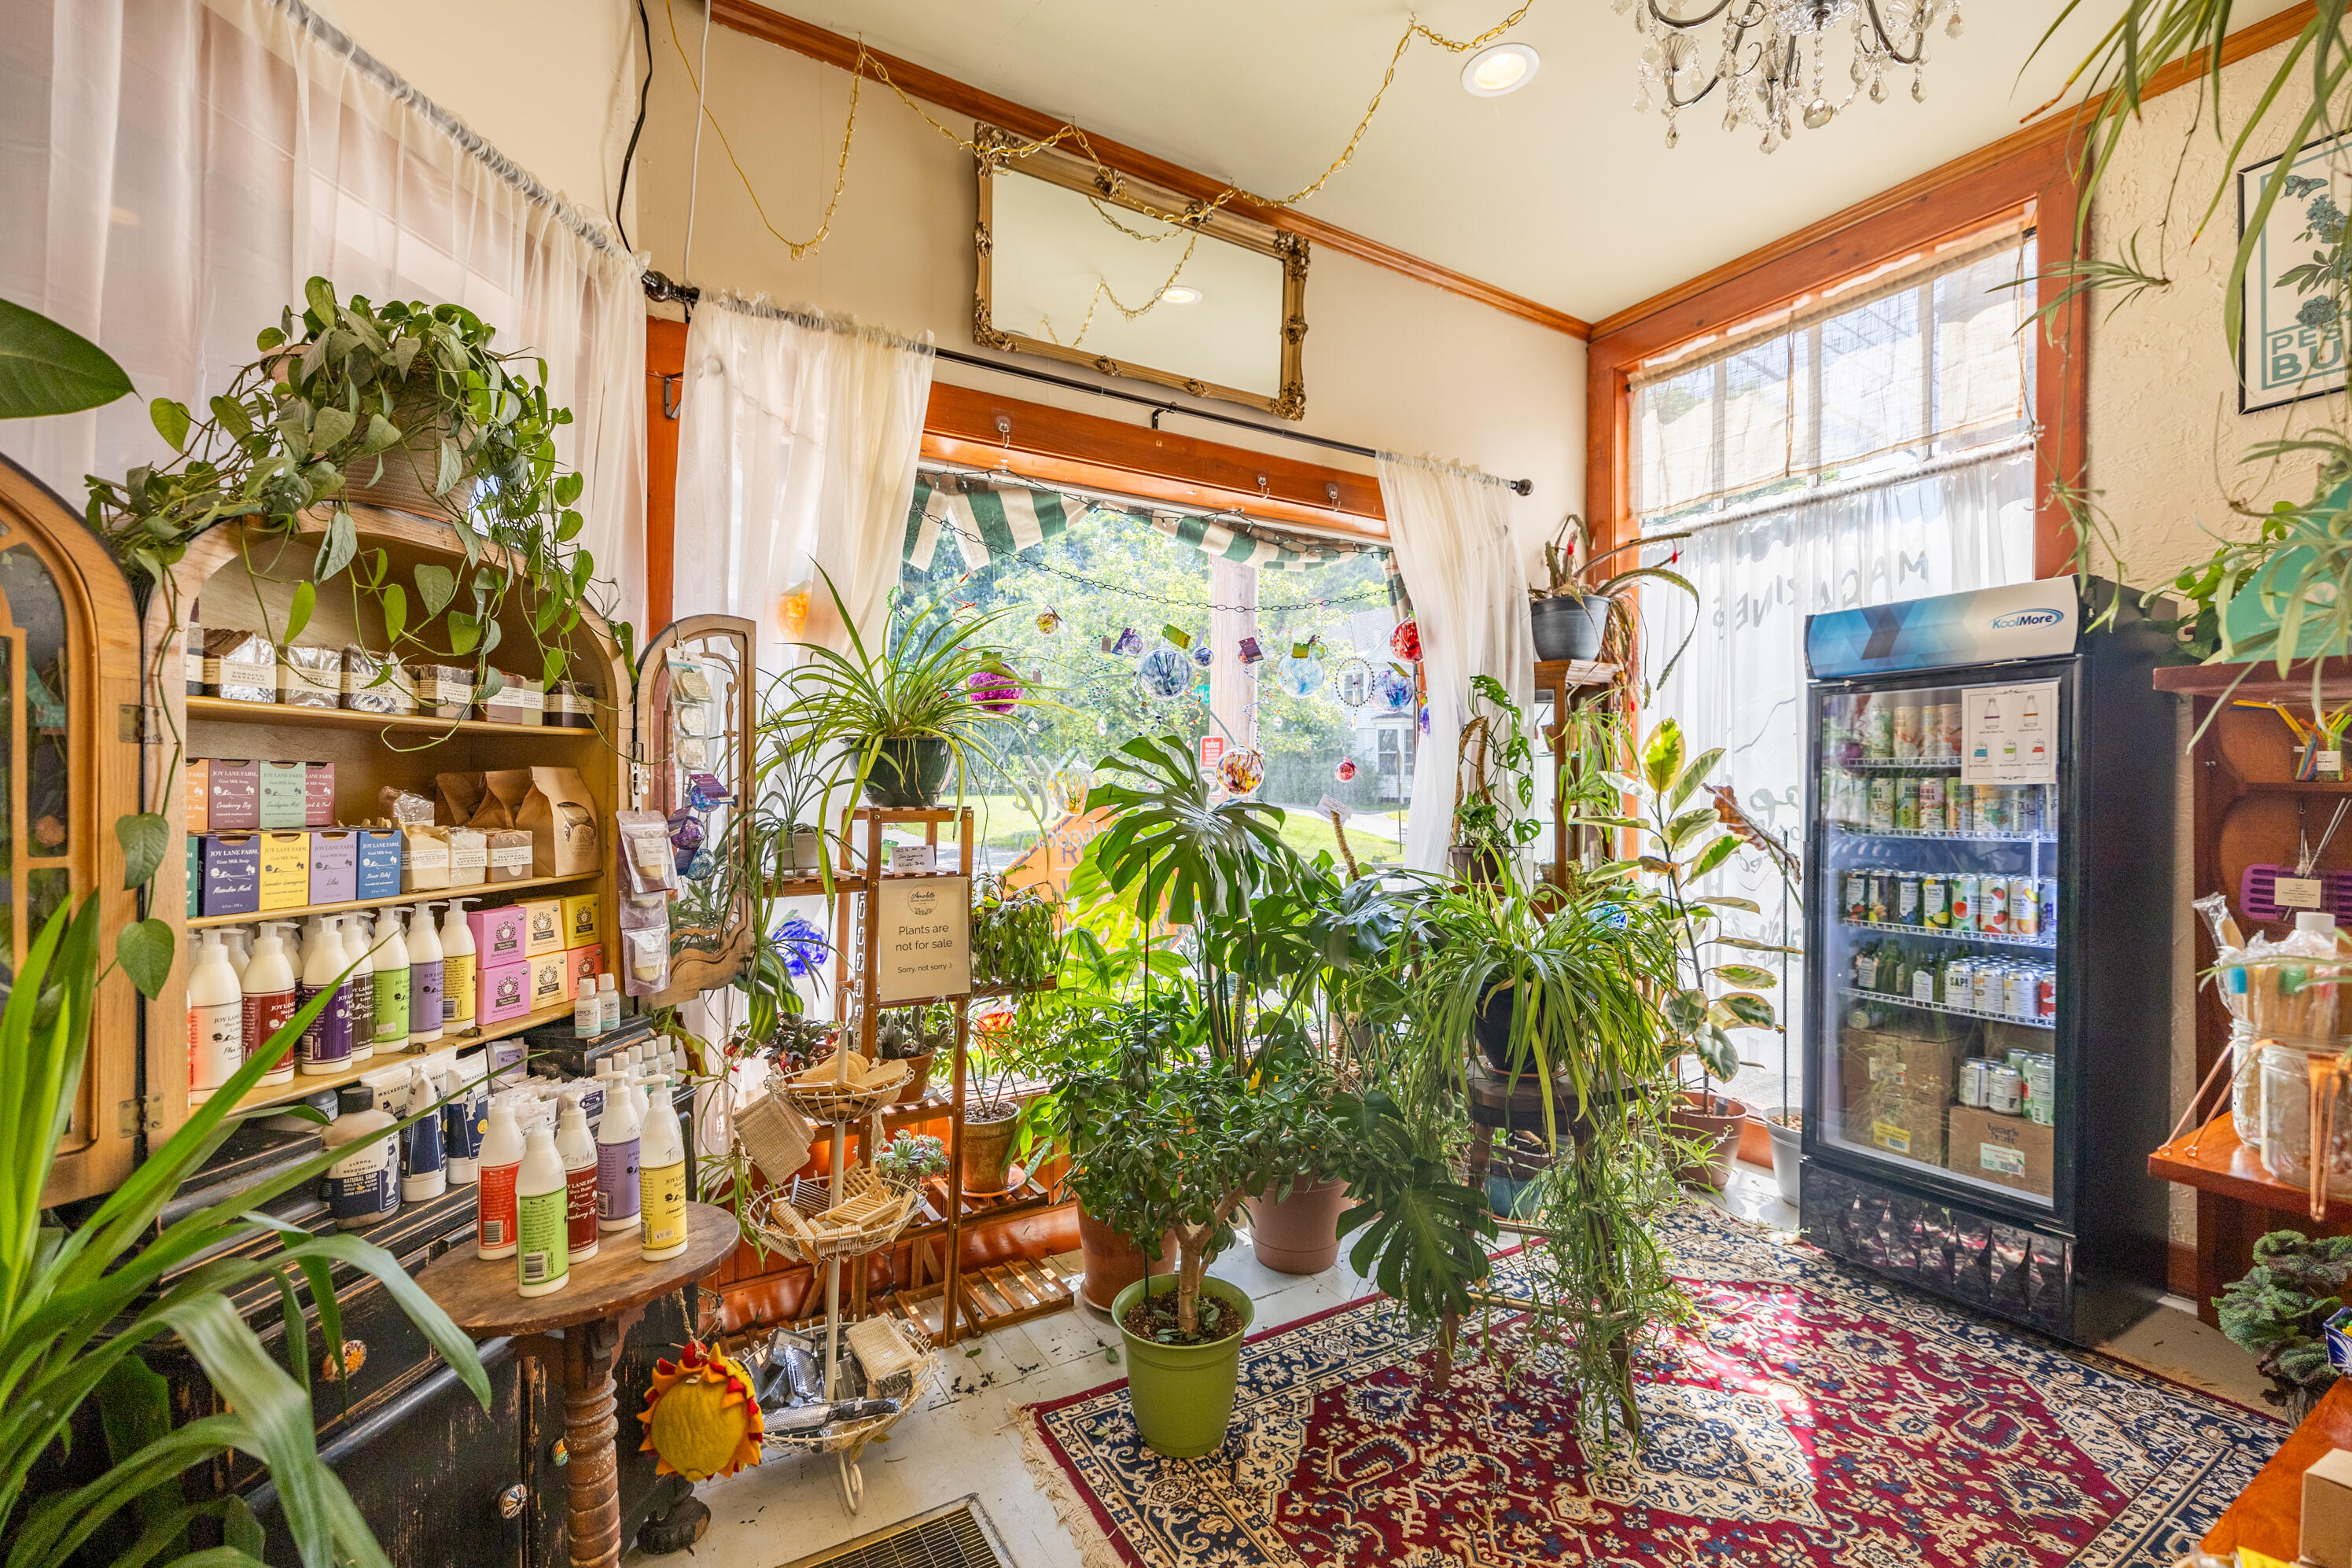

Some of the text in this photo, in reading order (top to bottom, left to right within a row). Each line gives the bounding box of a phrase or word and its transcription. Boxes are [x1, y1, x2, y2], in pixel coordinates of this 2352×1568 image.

[1992, 613, 2053, 630] KoolMore
[216, 801, 241, 810] Cranberry
[899, 924, 949, 936] Plants are
[896, 939, 953, 951] not for sale
[930, 963, 947, 972] sorry
[344, 1175, 364, 1183] NATURAL
[571, 1180, 587, 1189] LANE
